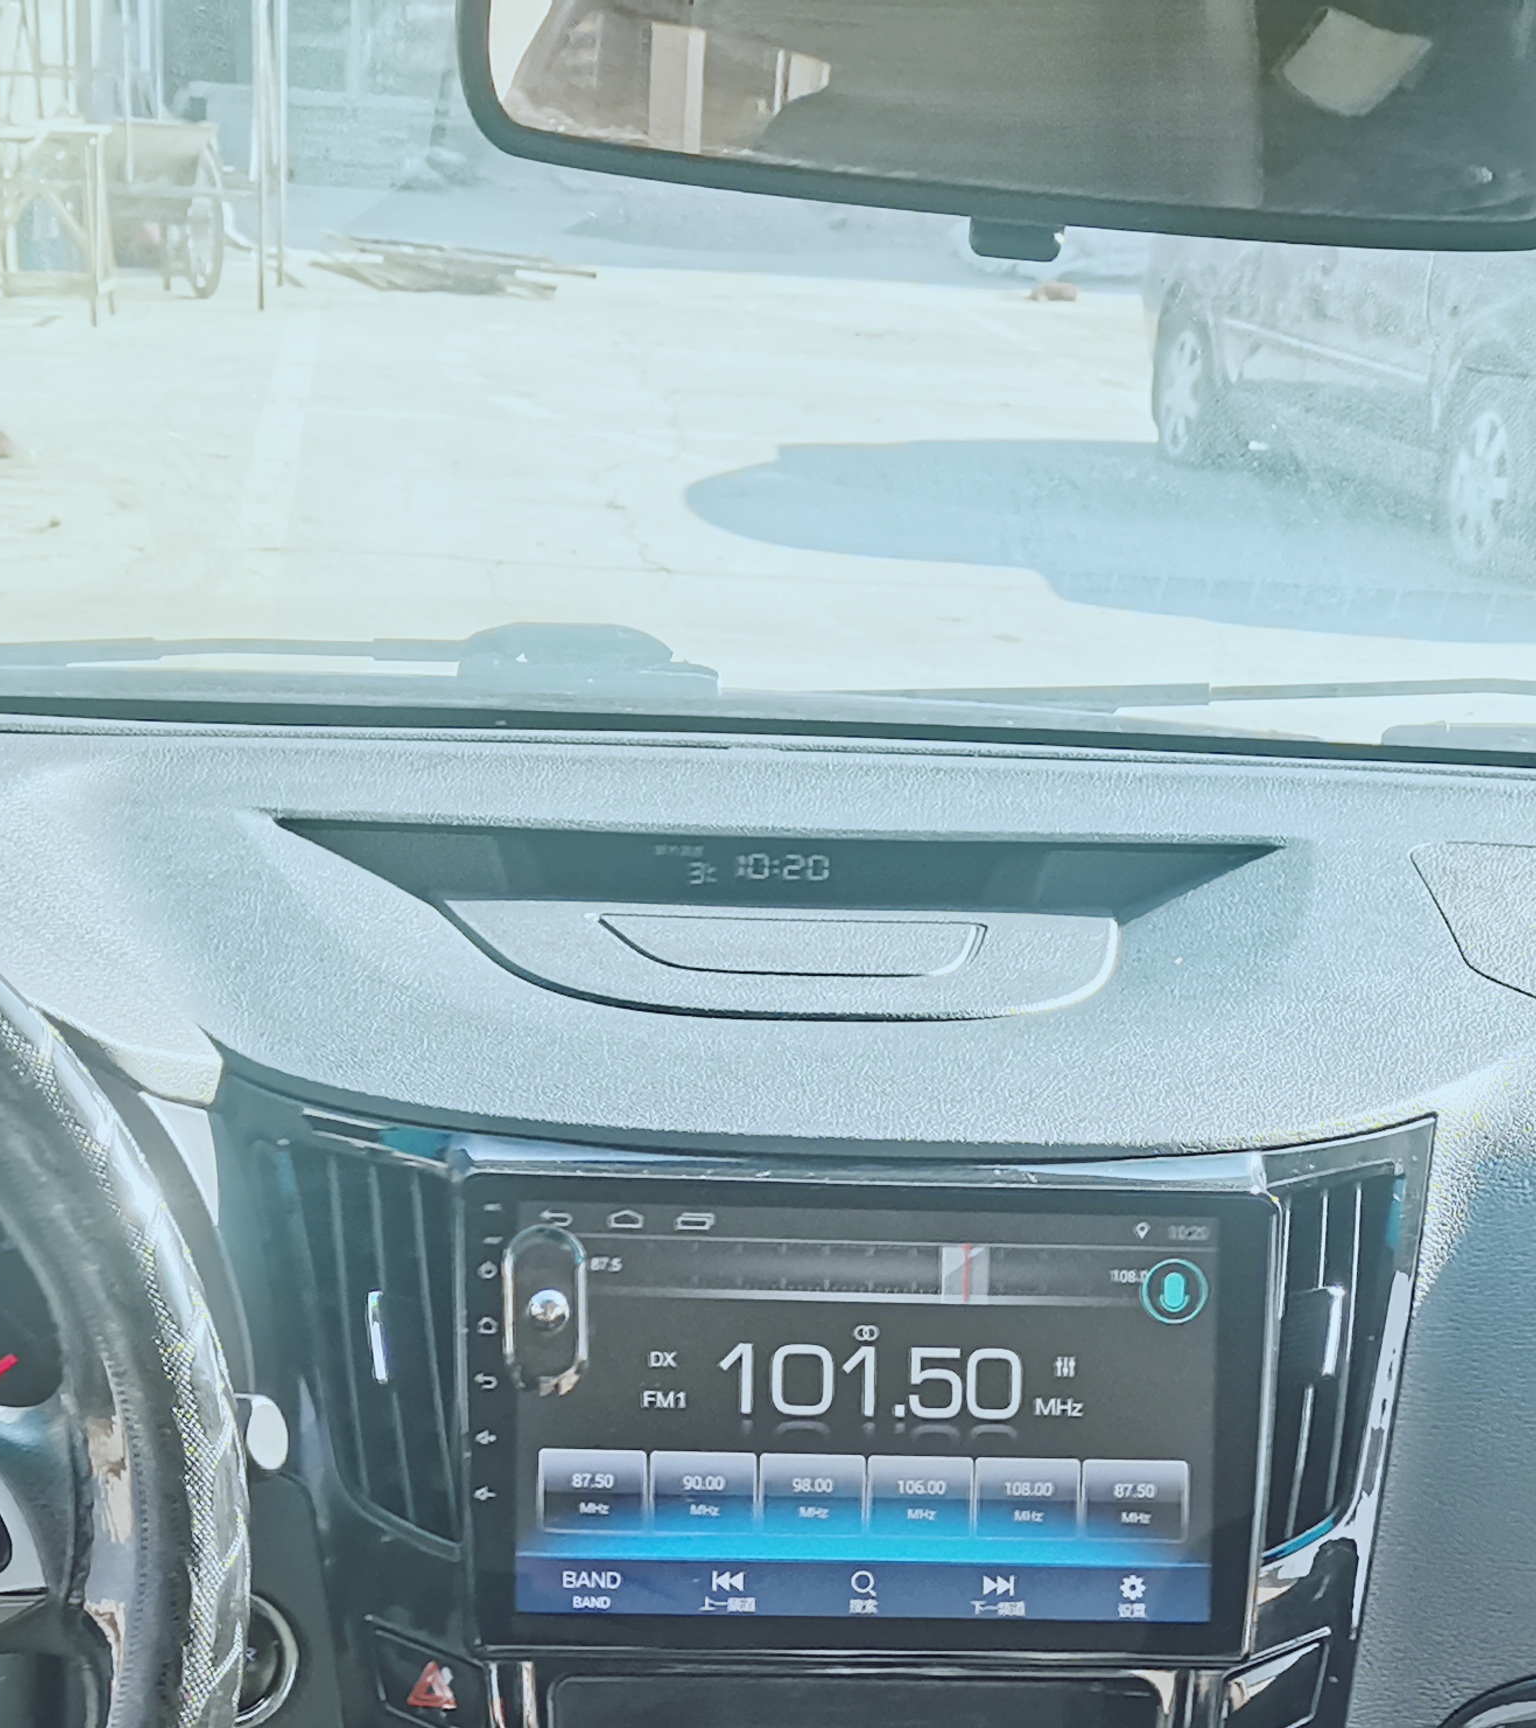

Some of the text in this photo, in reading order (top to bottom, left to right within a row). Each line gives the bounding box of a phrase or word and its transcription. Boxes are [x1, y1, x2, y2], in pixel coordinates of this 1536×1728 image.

[648, 1351, 677, 1369] DX
[718, 1343, 1022, 1420] 101.50
[642, 1390, 687, 1408] FM1
[1035, 1398, 1083, 1417] MHz
[571, 1472, 614, 1489] 87.50
[682, 1475, 726, 1491] 90.00
[792, 1477, 834, 1493] 98.00
[897, 1479, 946, 1495] 106.00
[1005, 1481, 1054, 1497] 108.00
[1113, 1483, 1156, 1499] 87.50
[563, 1570, 622, 1590] BAND
[572, 1596, 611, 1611] BAND
